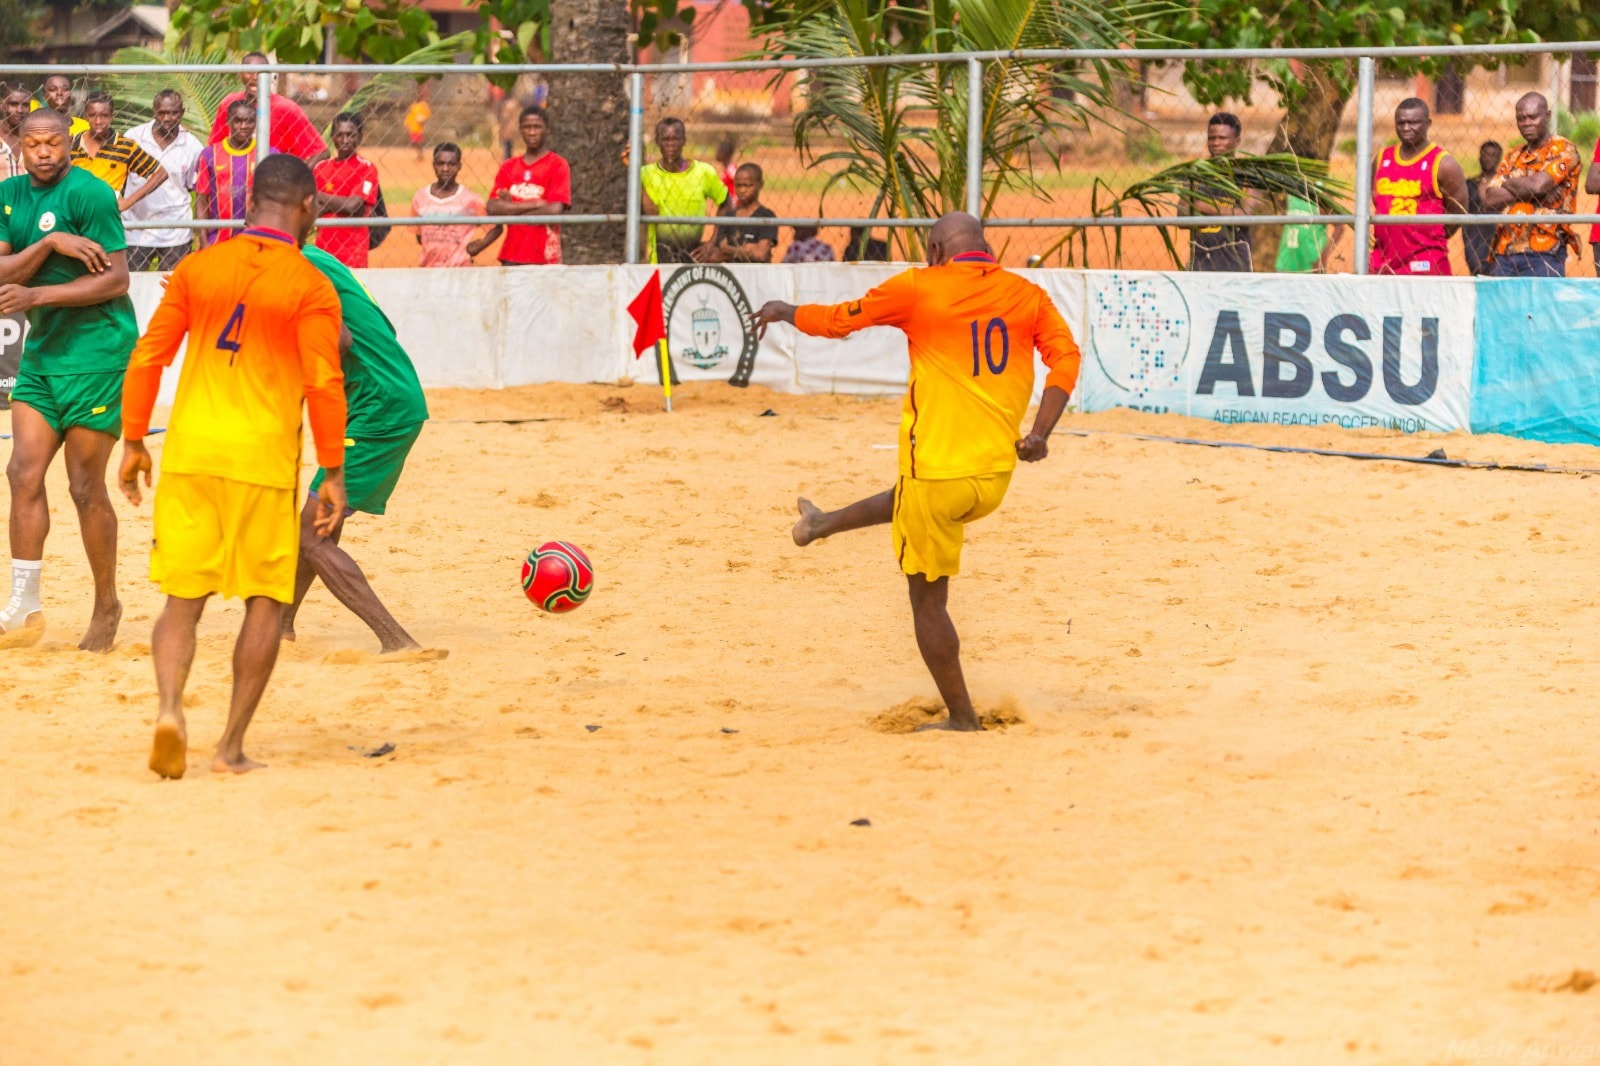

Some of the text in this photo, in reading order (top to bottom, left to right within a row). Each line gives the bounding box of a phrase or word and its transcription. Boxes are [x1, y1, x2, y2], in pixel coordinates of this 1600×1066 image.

[692, 266, 704, 281] OF
[216, 303, 246, 367] 4
[970, 317, 1010, 377] 10
[1196, 309, 1440, 406] ABSU
[1213, 409, 1269, 425] AFRICAN
[1273, 411, 1318, 427] BEACH
